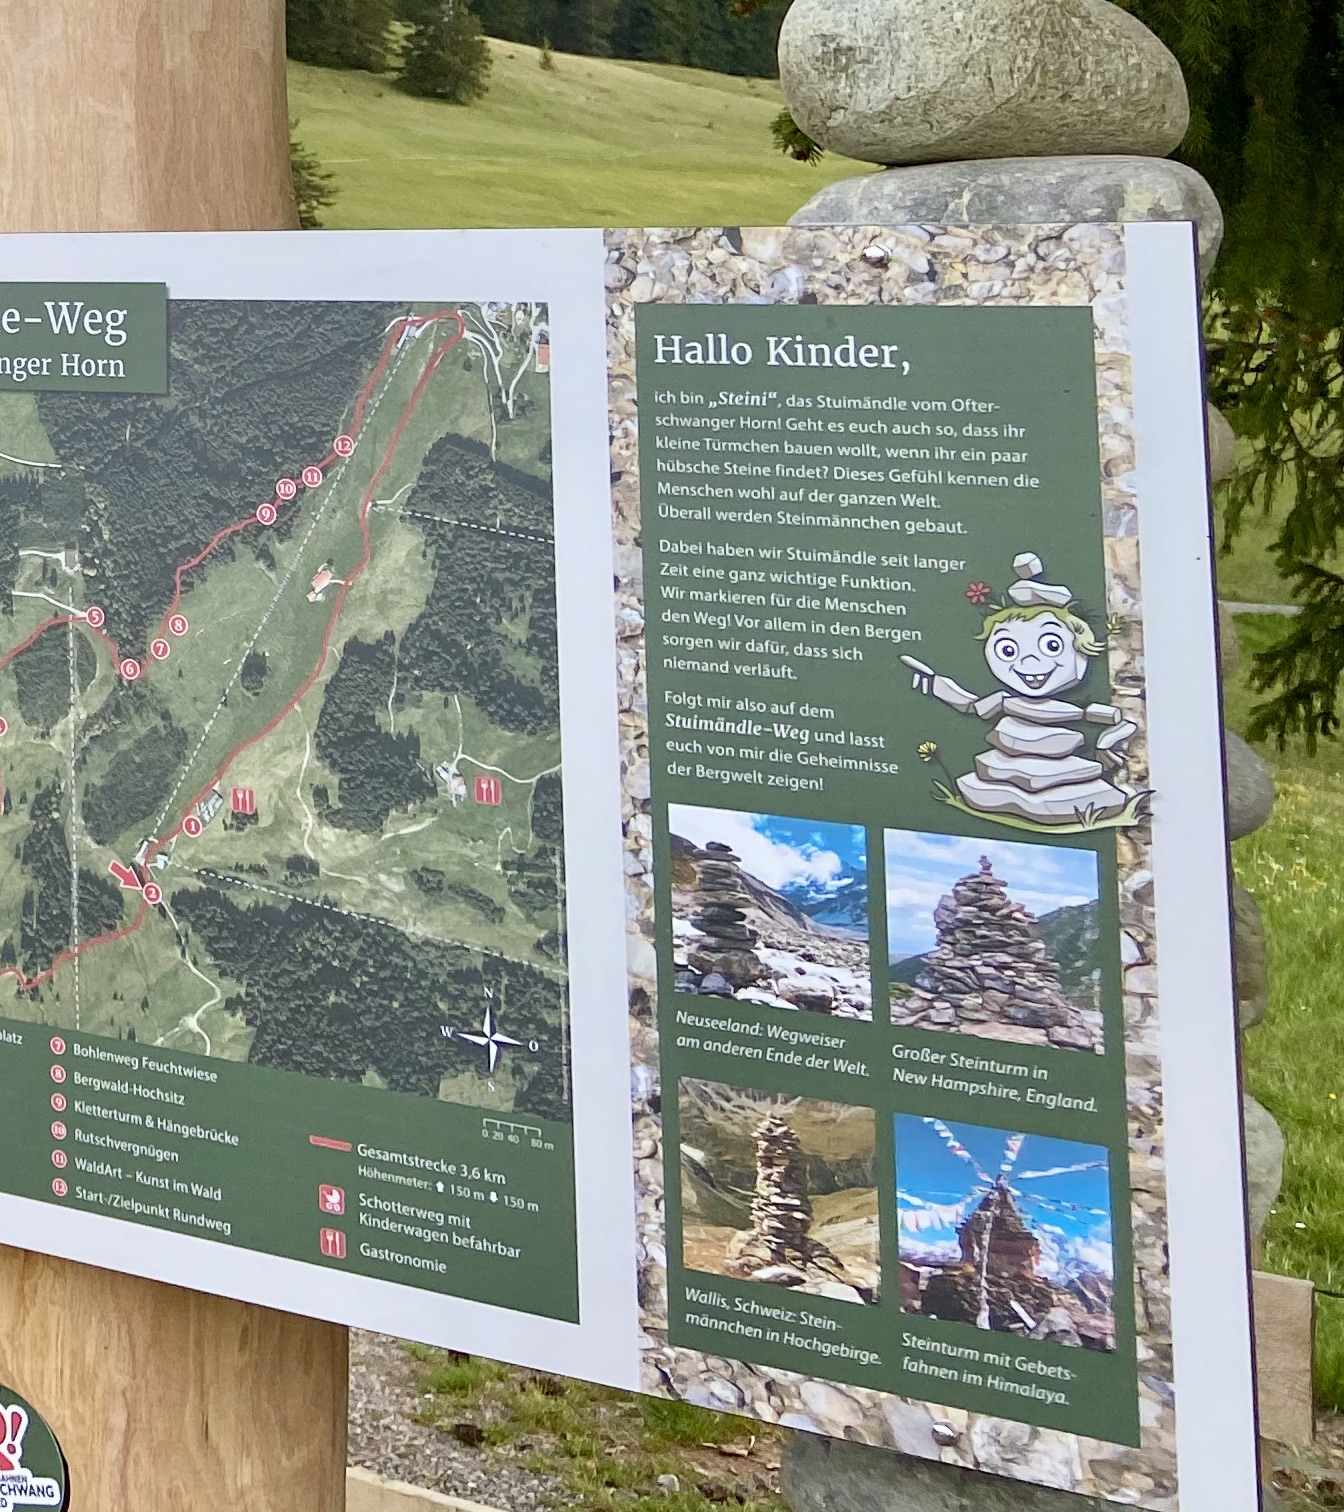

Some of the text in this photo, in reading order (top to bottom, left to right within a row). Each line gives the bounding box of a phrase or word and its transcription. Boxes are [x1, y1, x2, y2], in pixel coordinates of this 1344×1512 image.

[60, 353, 126, 377] Horn
[653, 333, 910, 375] Hallo Kinder,
[680, 390, 704, 404] bin
[785, 393, 813, 408] das
[816, 394, 907, 410] Stuimändle
[910, 400, 947, 411] vom
[951, 398, 1001, 412] Ofter-
[655, 413, 1026, 438] schwanger Horn! Geht es euch auch so, dass ihr
[655, 435, 1029, 464] kleine Türmchen bauen wollt, wenn ihr ein paar
[656, 458, 1040, 488] hübsche Steine findet? Dieses Gefühl kennen die
[657, 481, 941, 508] Menschen wohl auf der ganzen Welt.
[658, 504, 968, 534] Überall werden Steinmännchen gebaut.
[659, 539, 967, 573] Dabei haben wir Stuimändle seit langer
[660, 562, 917, 592] Zeit eine ganz wichtige Funktion.
[660, 585, 907, 615] Wir markieren für die Menschen
[661, 608, 922, 643] den Weg! Vor allem in den Bergen
[662, 635, 863, 660] sorgen wir dafür, dass sich
[663, 655, 798, 680] niemand verläuft.
[664, 690, 835, 719] Folgt mir also auf dem
[665, 713, 885, 748] Stuimändle-Weg und lasst
[666, 739, 899, 774] euch von mir die Geheimnisse
[667, 761, 824, 791] der Bergwelt zeigen!
[676, 1010, 847, 1048] Neuseeland: Wegweiser
[73, 1043, 218, 1082] Bohlenweg Feuchtwiese
[676, 1036, 870, 1077] am anderen Ende der Welt.
[892, 1044, 1048, 1080] Großer Steinturm in
[892, 1067, 1098, 1112] New Hampshire, England.
[74, 1100, 239, 1146] Kletterturm Hängebrücke
[74, 1157, 222, 1201] WaldArt Kunst im Wald
[357, 1143, 506, 1184] Gesamtstrecke 3,6 km
[173, 1207, 231, 1234] Rundweg
[359, 1192, 471, 1229] Schotterweg mit
[359, 1211, 521, 1258] Kinderwagen befahrbar
[359, 1242, 447, 1273] Gastronomie
[685, 1286, 842, 1331] Wallis, Schweiz: Stein-
[685, 1313, 883, 1365] männchen in Hochgebirge.
[901, 1332, 1077, 1380] Steinturm mit Gebets-
[902, 1356, 1070, 1405] fahnen im Himalaya.
